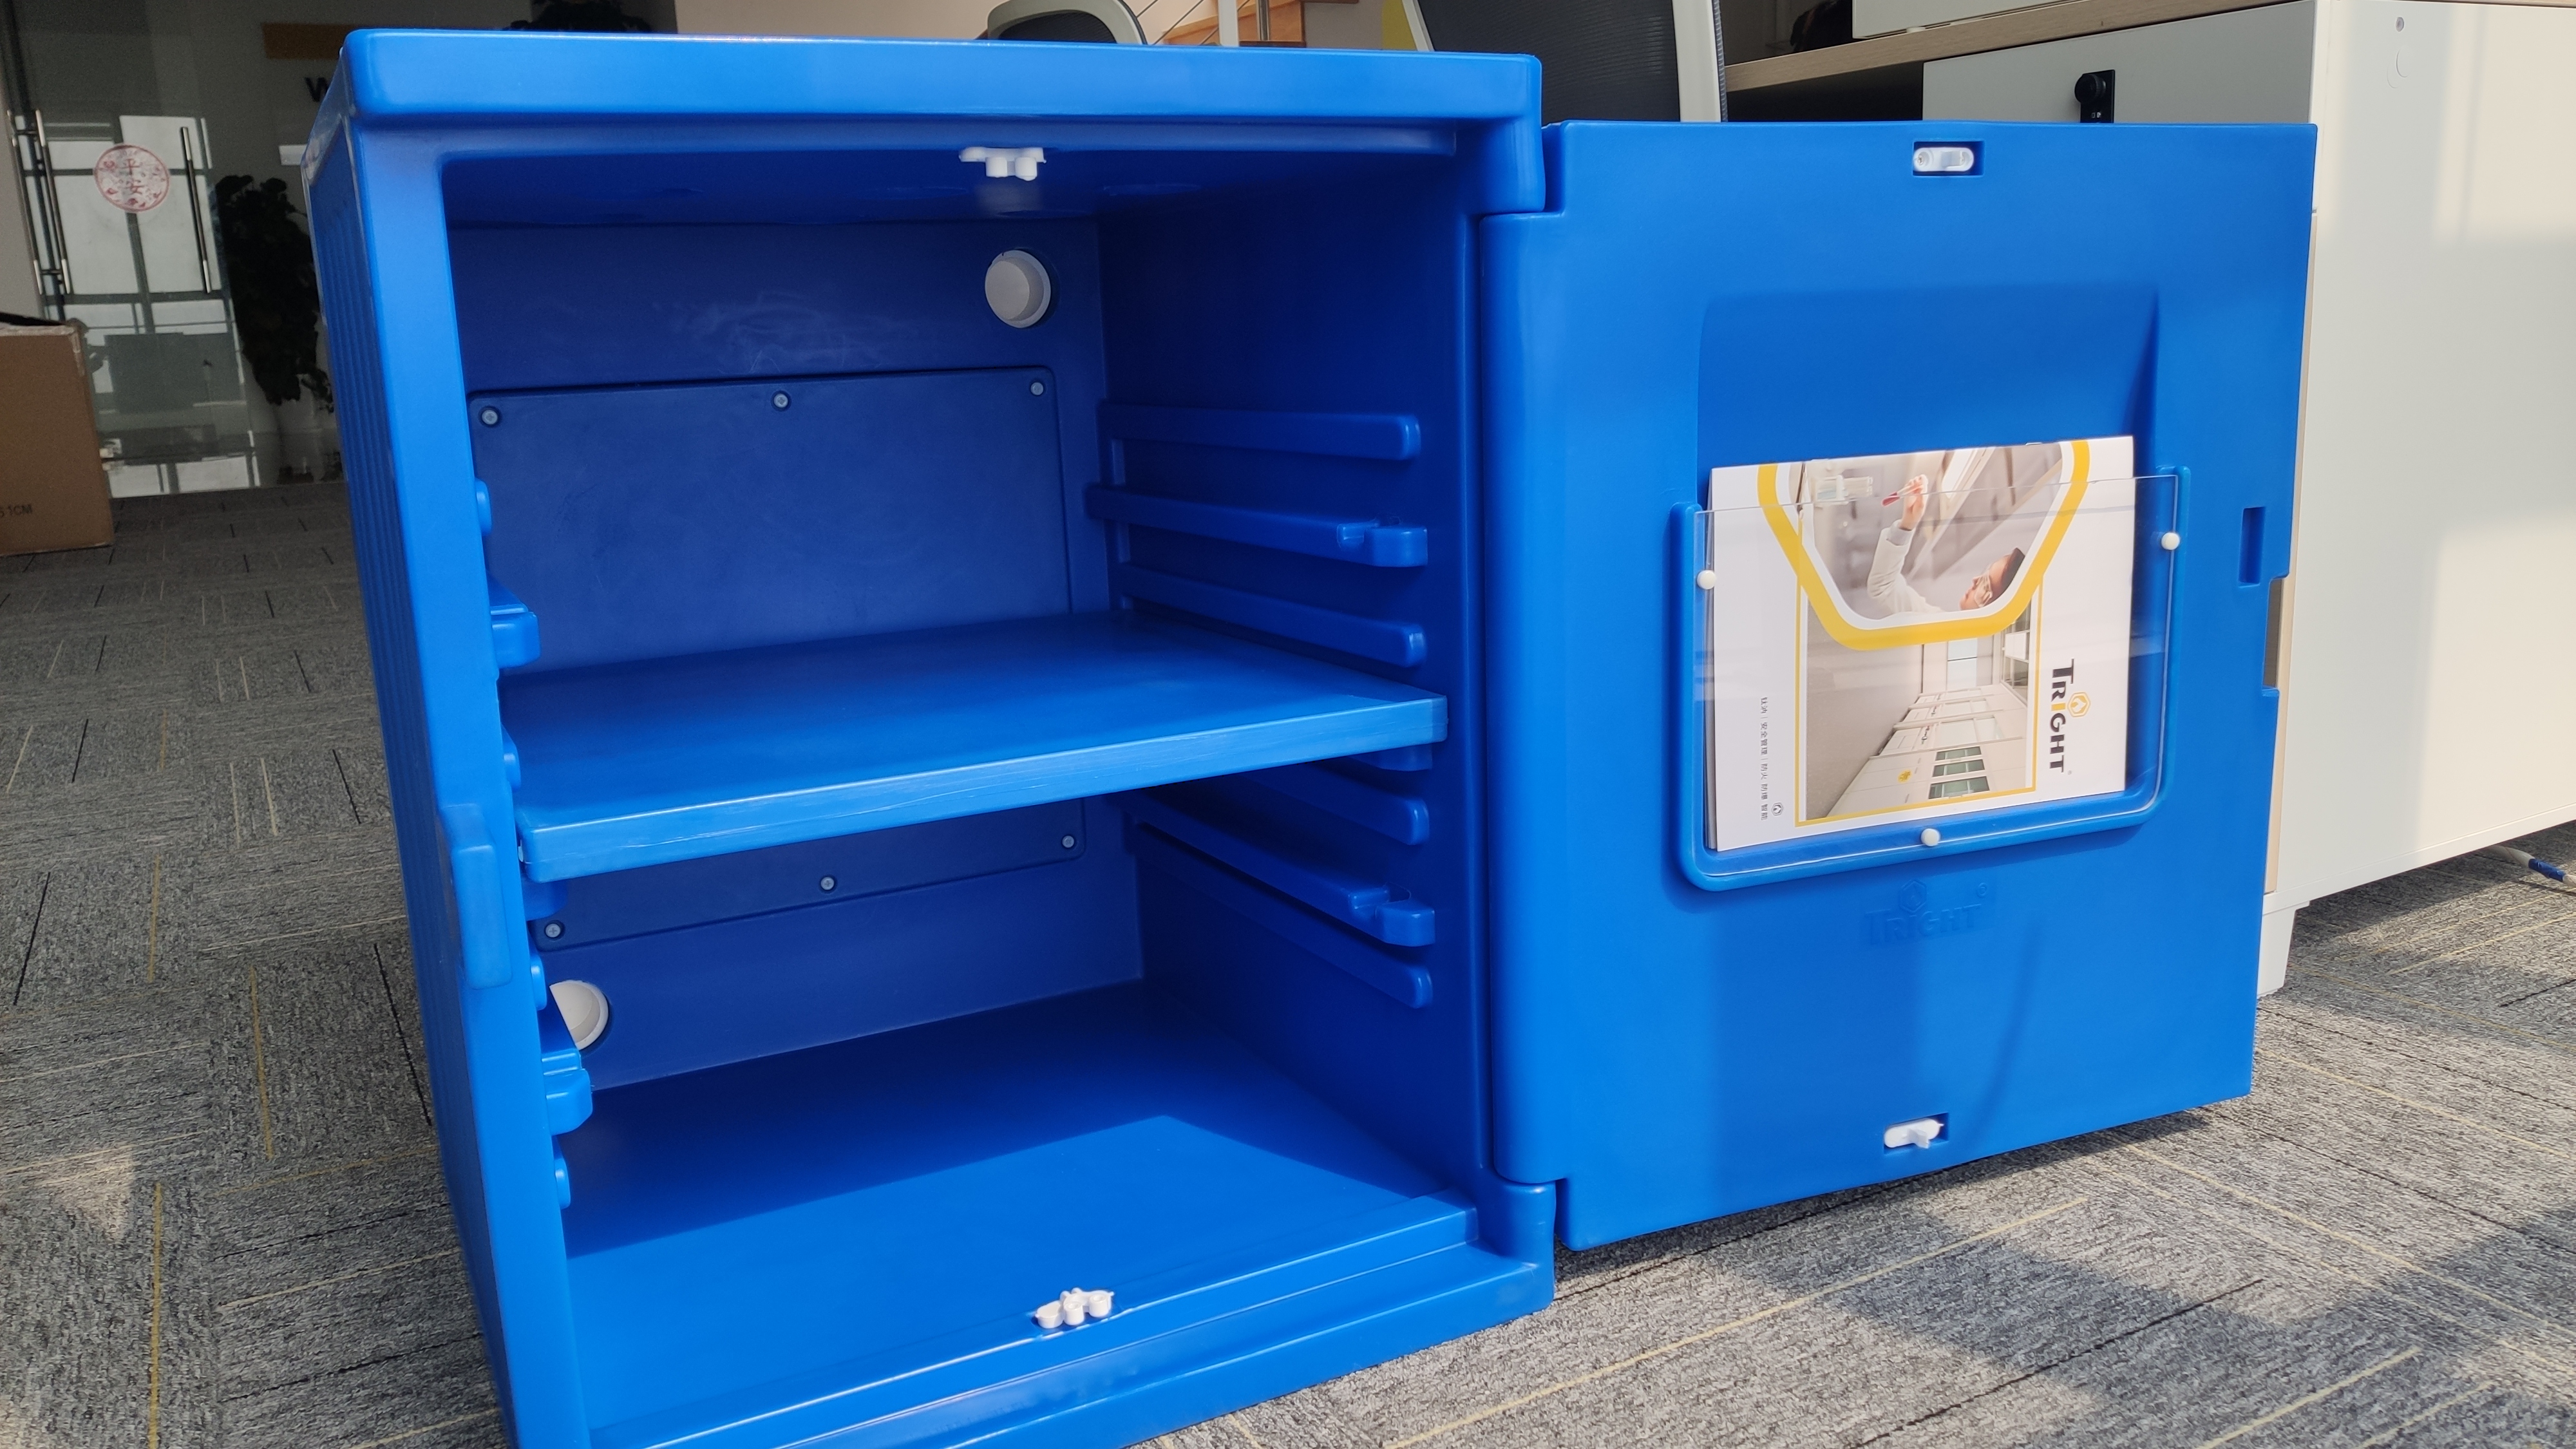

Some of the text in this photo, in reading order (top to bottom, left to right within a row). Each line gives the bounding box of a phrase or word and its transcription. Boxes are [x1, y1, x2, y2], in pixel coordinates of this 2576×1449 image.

[1760, 763, 1768, 780] 防火
[1760, 783, 1768, 800] 防爆
[1760, 804, 1768, 820] 智能
